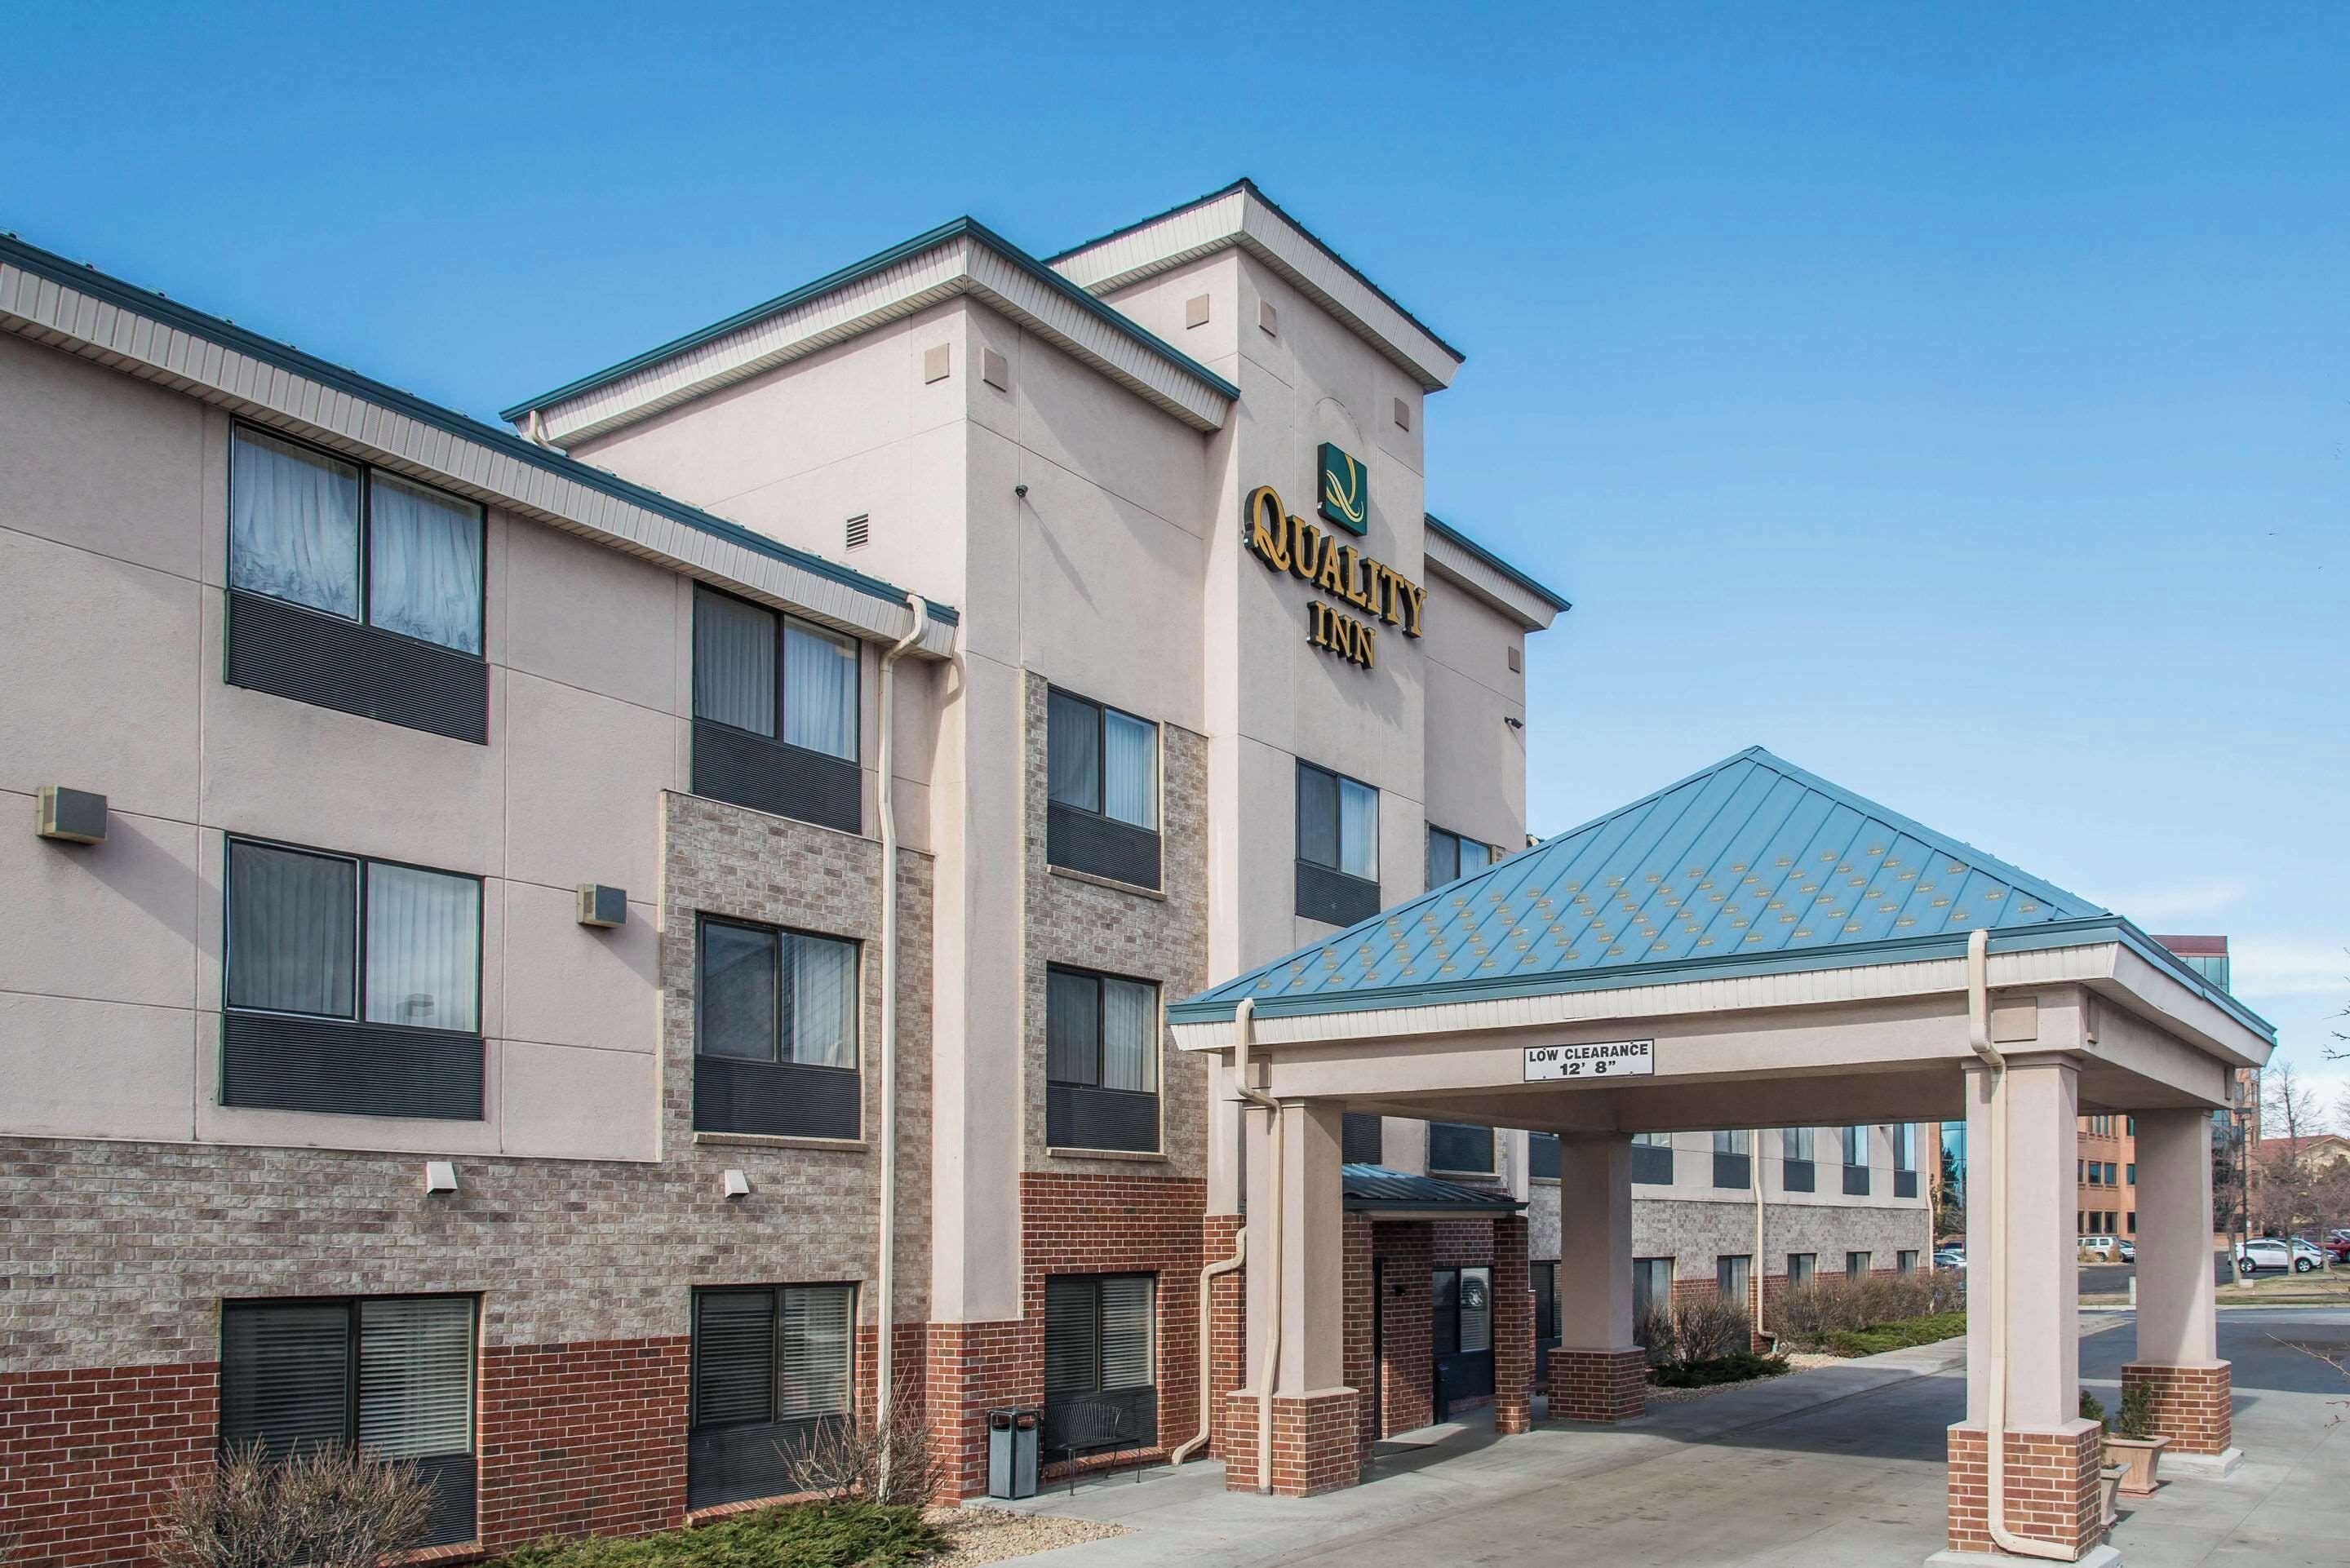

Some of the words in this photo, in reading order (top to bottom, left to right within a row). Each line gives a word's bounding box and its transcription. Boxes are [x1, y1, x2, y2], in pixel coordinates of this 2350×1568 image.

[1245, 485, 1427, 638] QUALITY
[1307, 600, 1377, 669] INN
[1529, 1049, 1559, 1062] LOW
[1564, 1043, 1648, 1060] CLEARANCE
[1559, 1062, 1585, 1076] 12'
